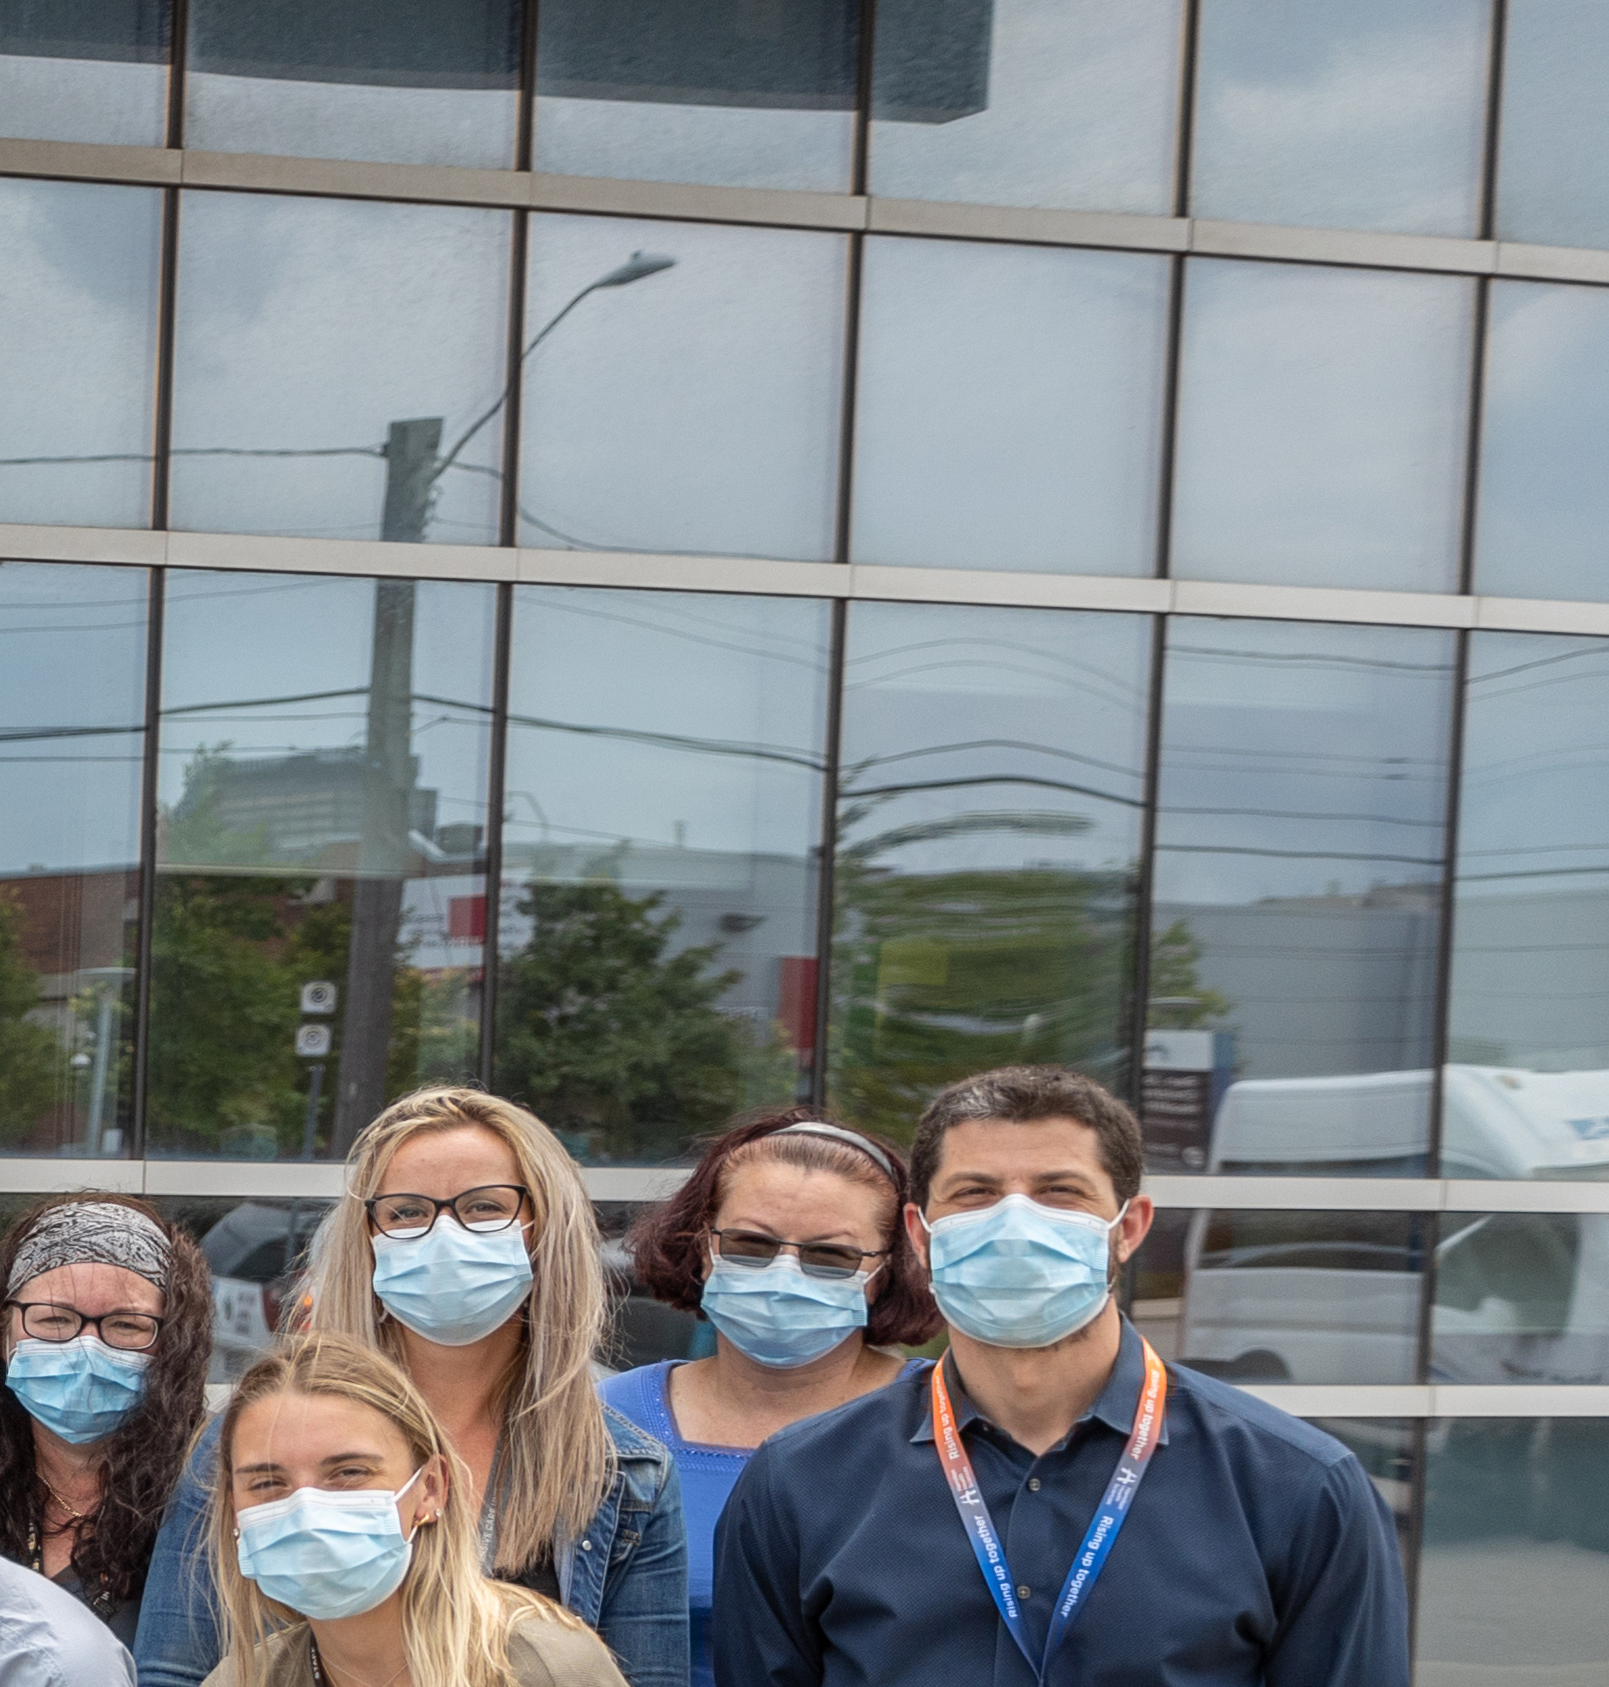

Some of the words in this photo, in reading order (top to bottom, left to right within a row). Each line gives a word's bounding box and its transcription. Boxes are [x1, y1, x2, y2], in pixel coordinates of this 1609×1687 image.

[1146, 1369, 1160, 1400] Rising
[941, 1413, 952, 1427] up
[1144, 1401, 1155, 1413] up
[944, 1426, 959, 1460] Rising
[1131, 1412, 1154, 1460] together
[975, 1515, 1000, 1564] together
[1088, 1515, 1114, 1550] Rising
[993, 1565, 1007, 1581] up
[1082, 1552, 1095, 1567] up
[1000, 1582, 1018, 1618] Rising
[1060, 1568, 1090, 1618] together
